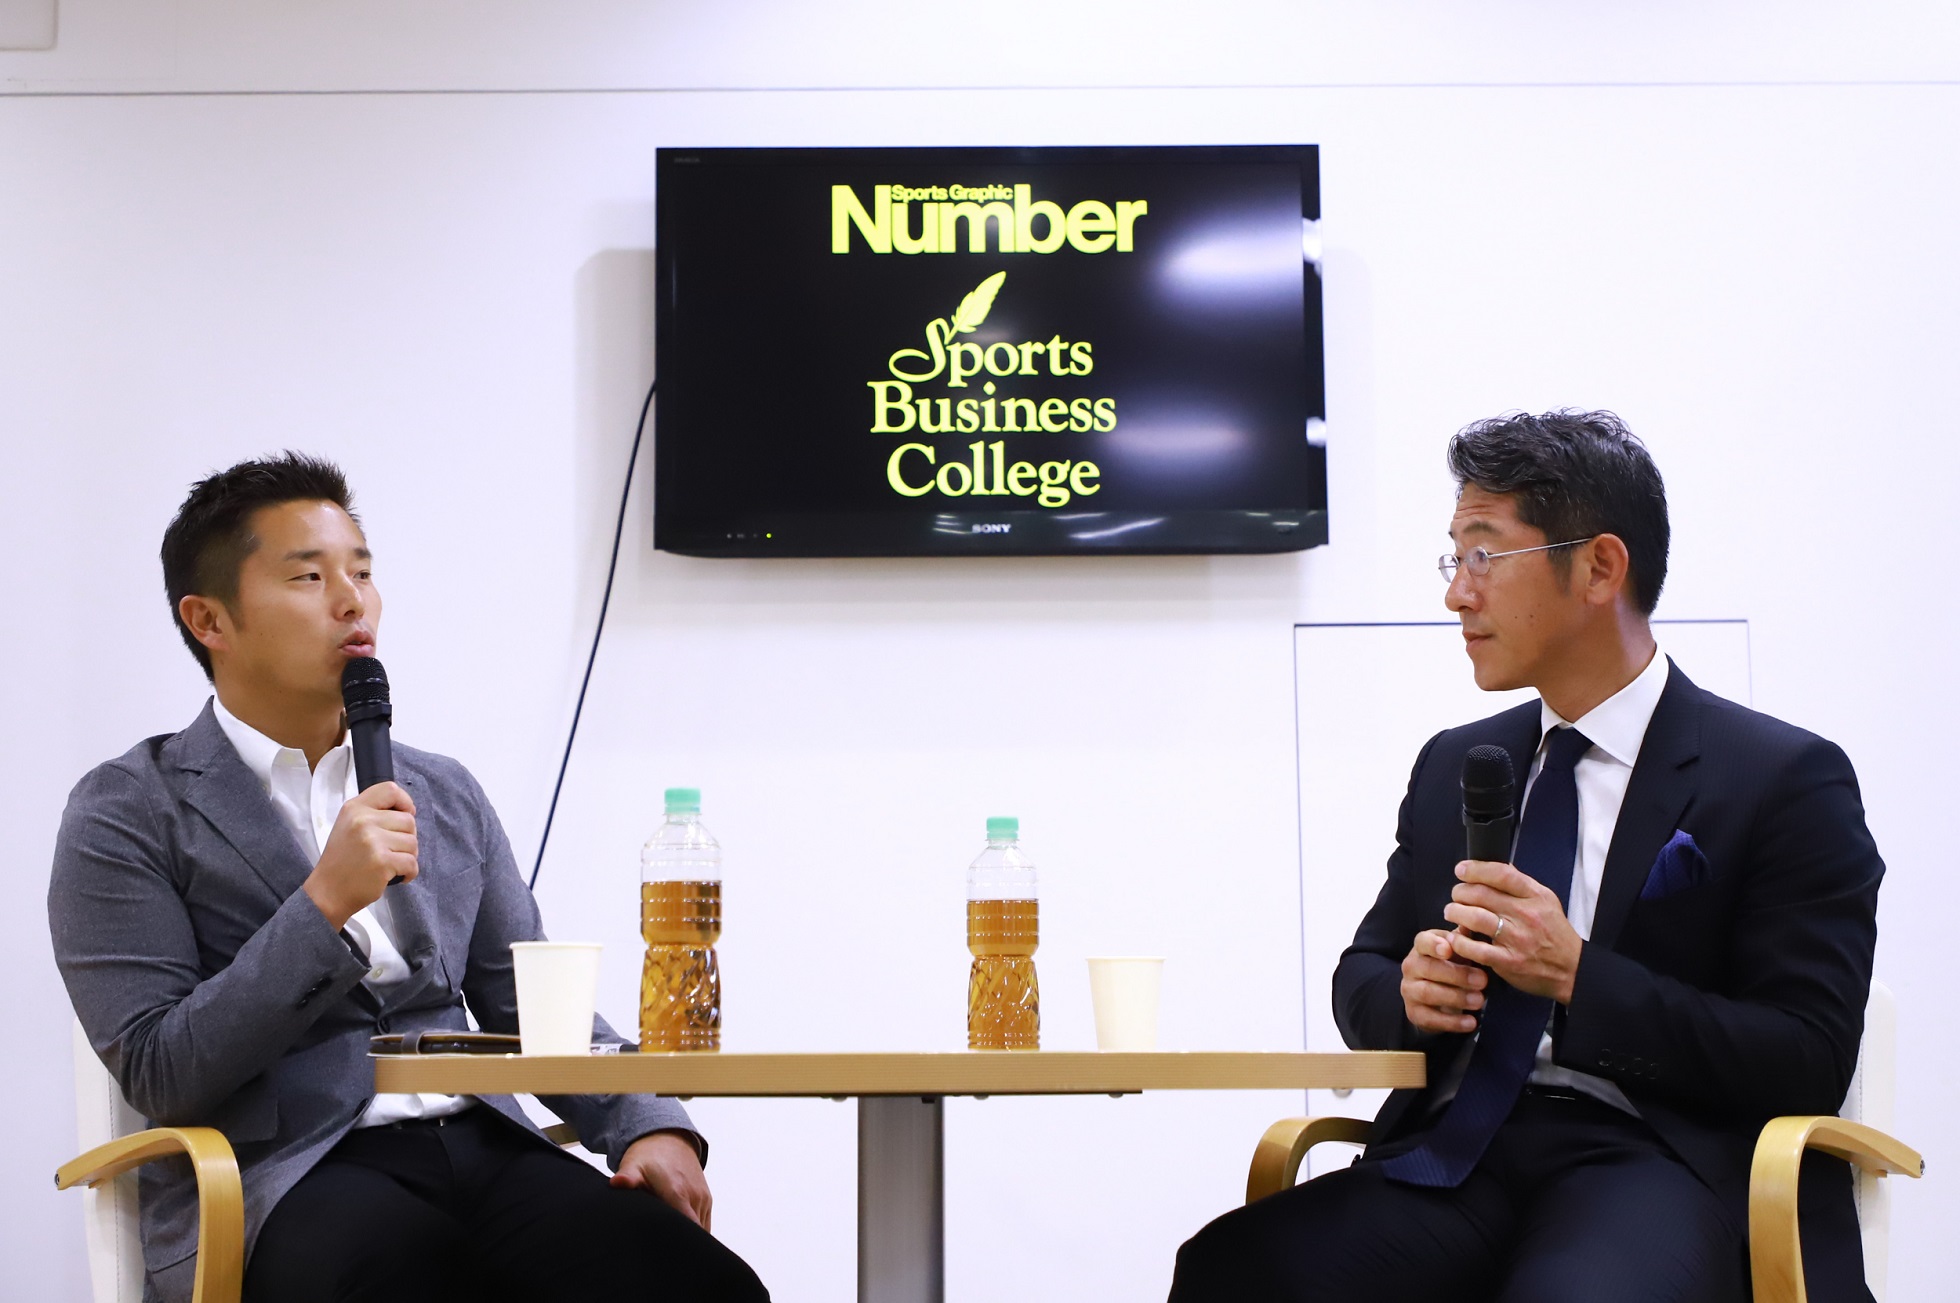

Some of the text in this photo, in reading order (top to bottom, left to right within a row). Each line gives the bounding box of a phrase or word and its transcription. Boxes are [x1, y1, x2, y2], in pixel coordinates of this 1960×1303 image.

[832, 184, 1147, 254] Number
[891, 184, 1014, 202] Sports Graphic
[888, 317, 1094, 388] Sports
[867, 381, 1117, 434] Business
[887, 441, 1101, 508] College
[972, 523, 1012, 534] SONY
